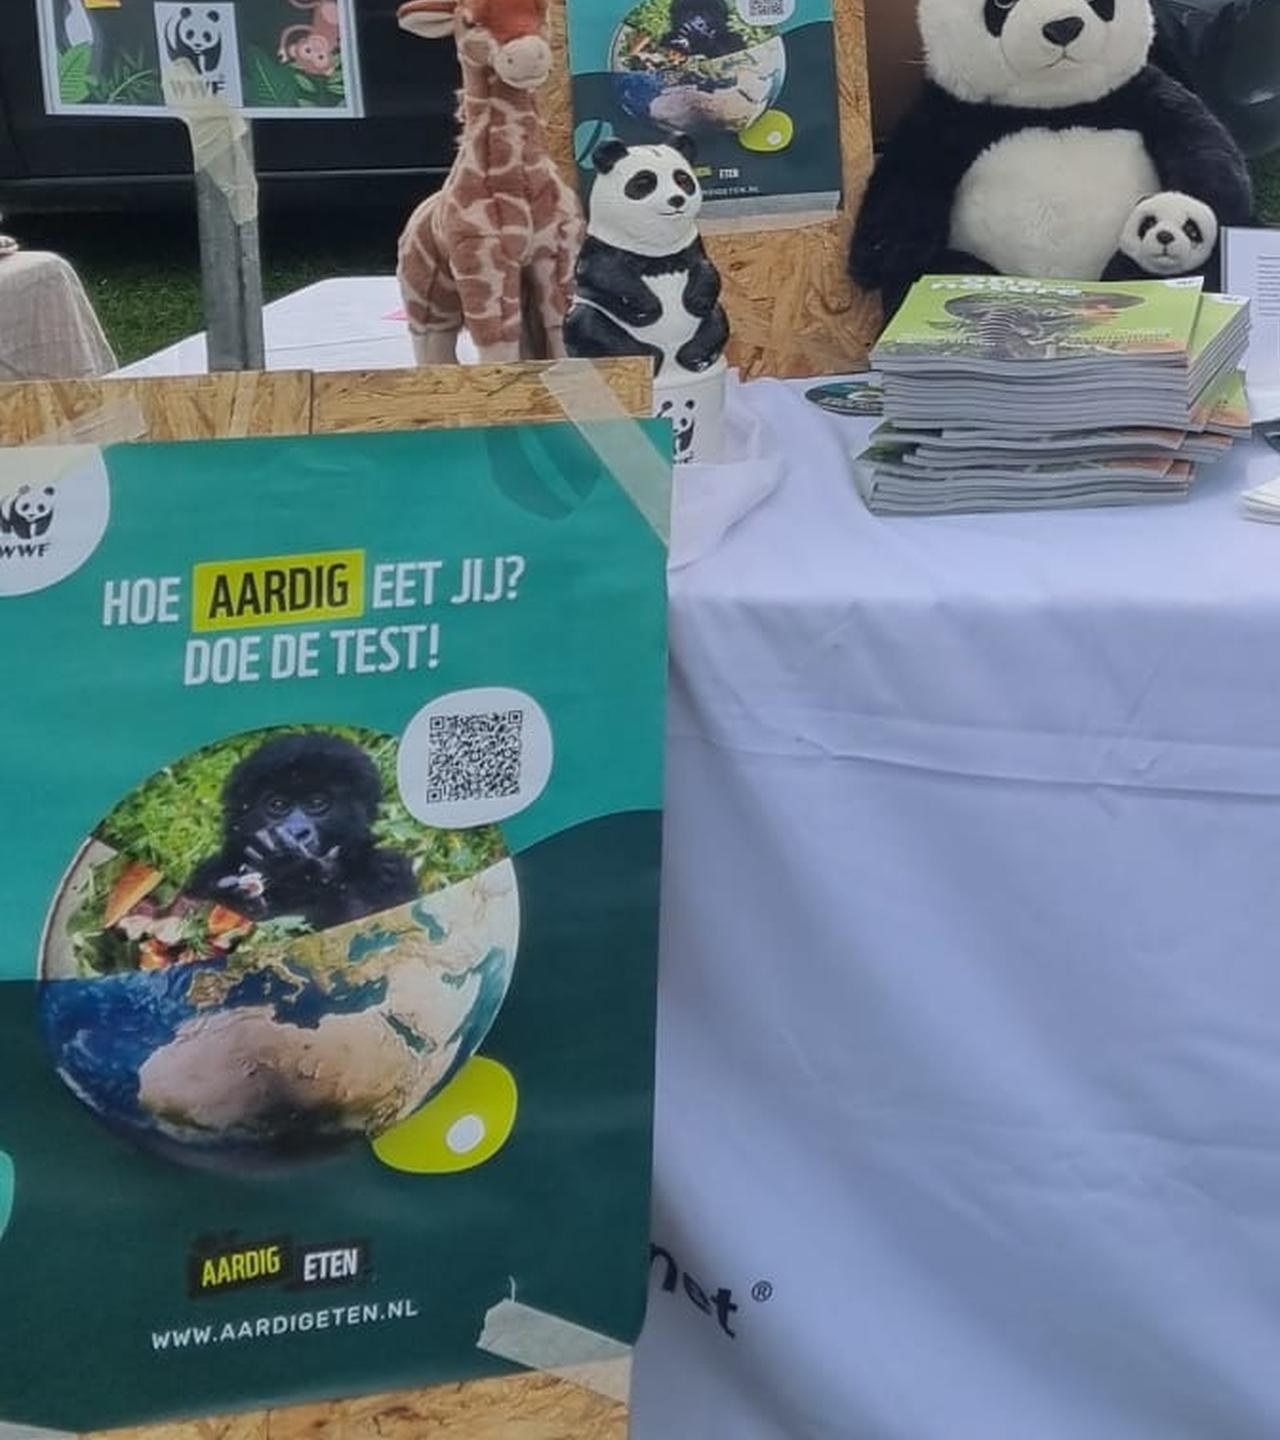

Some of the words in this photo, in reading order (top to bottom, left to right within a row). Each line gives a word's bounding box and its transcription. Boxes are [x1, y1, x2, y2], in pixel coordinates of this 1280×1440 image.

[102, 576, 181, 626] HOE
[207, 562, 349, 619] AARDIG
[371, 559, 442, 610] EET
[450, 554, 526, 605] JIJ?
[184, 635, 260, 686] DOE
[271, 632, 319, 679] DE
[329, 623, 441, 677] TEST!
[201, 1245, 280, 1288] AARDIG
[303, 1248, 358, 1283] ETEN
[151, 1300, 418, 1350] WWW.AARDIGETEN.NL
